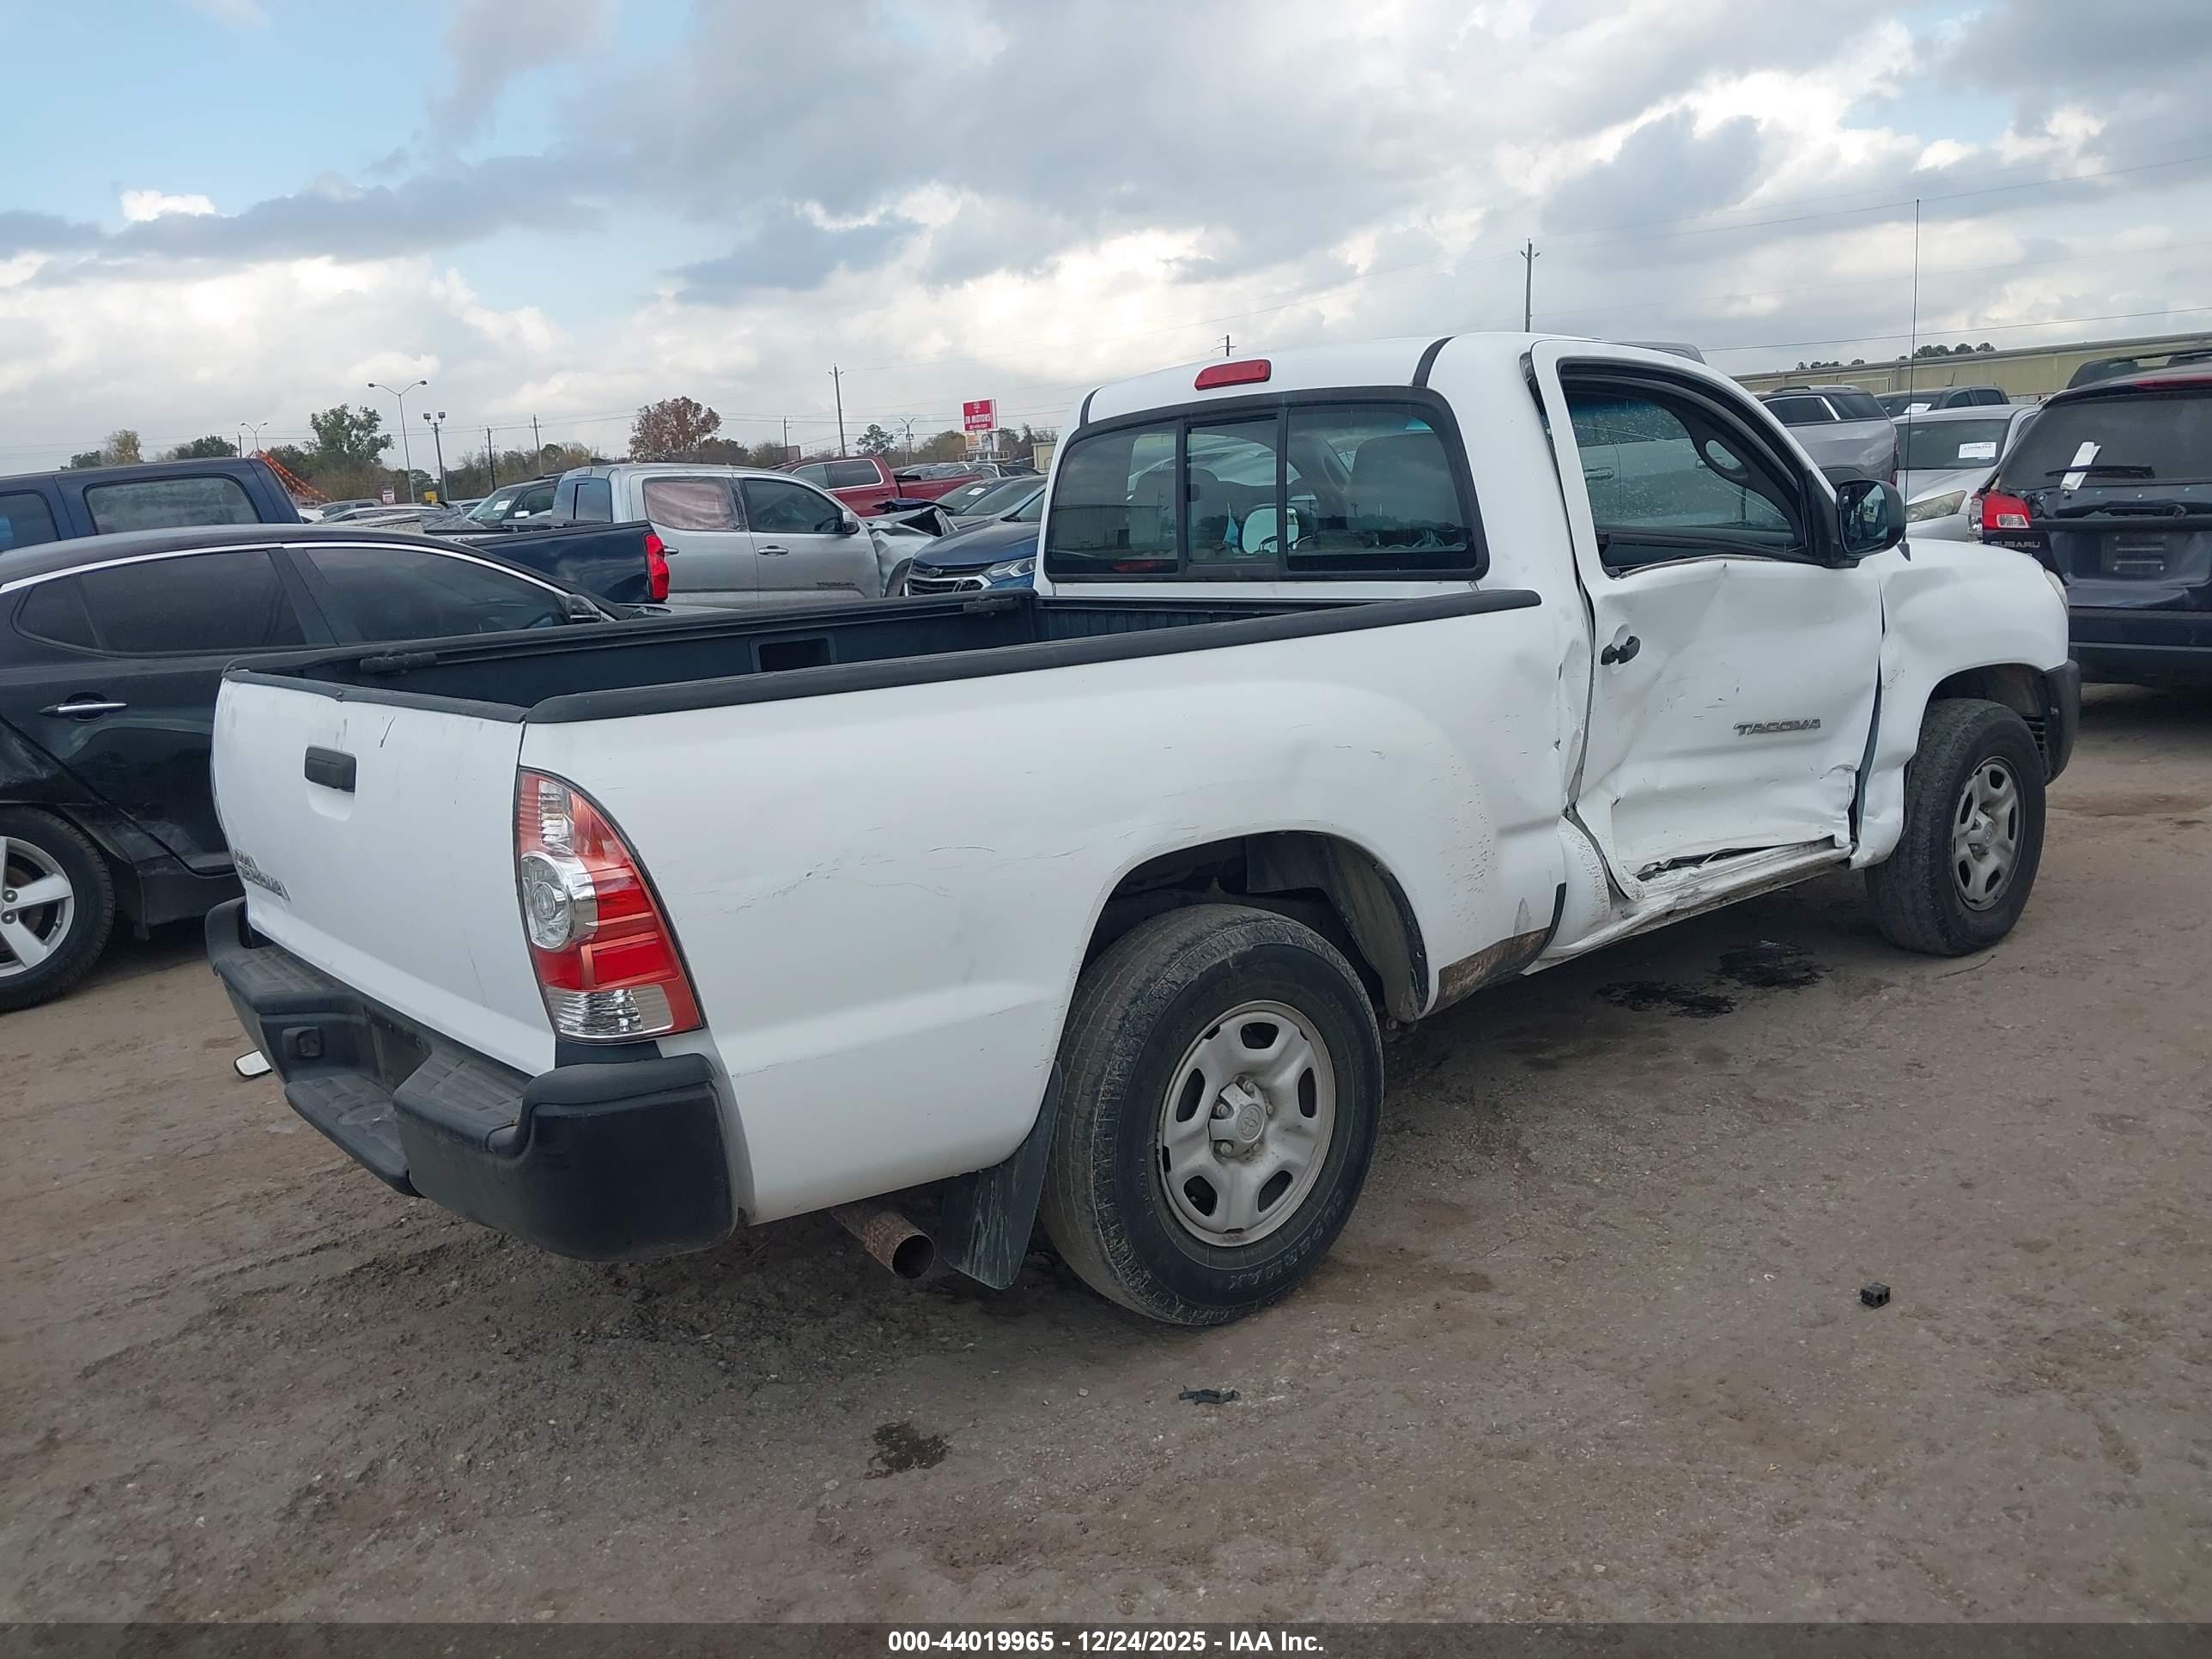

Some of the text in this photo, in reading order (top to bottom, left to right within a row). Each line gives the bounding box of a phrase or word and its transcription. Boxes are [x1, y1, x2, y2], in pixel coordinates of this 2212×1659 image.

[971, 413, 991, 423] MOTORS
[1990, 540, 2041, 549] SUBARU
[1733, 718, 1821, 736] TACOMA
